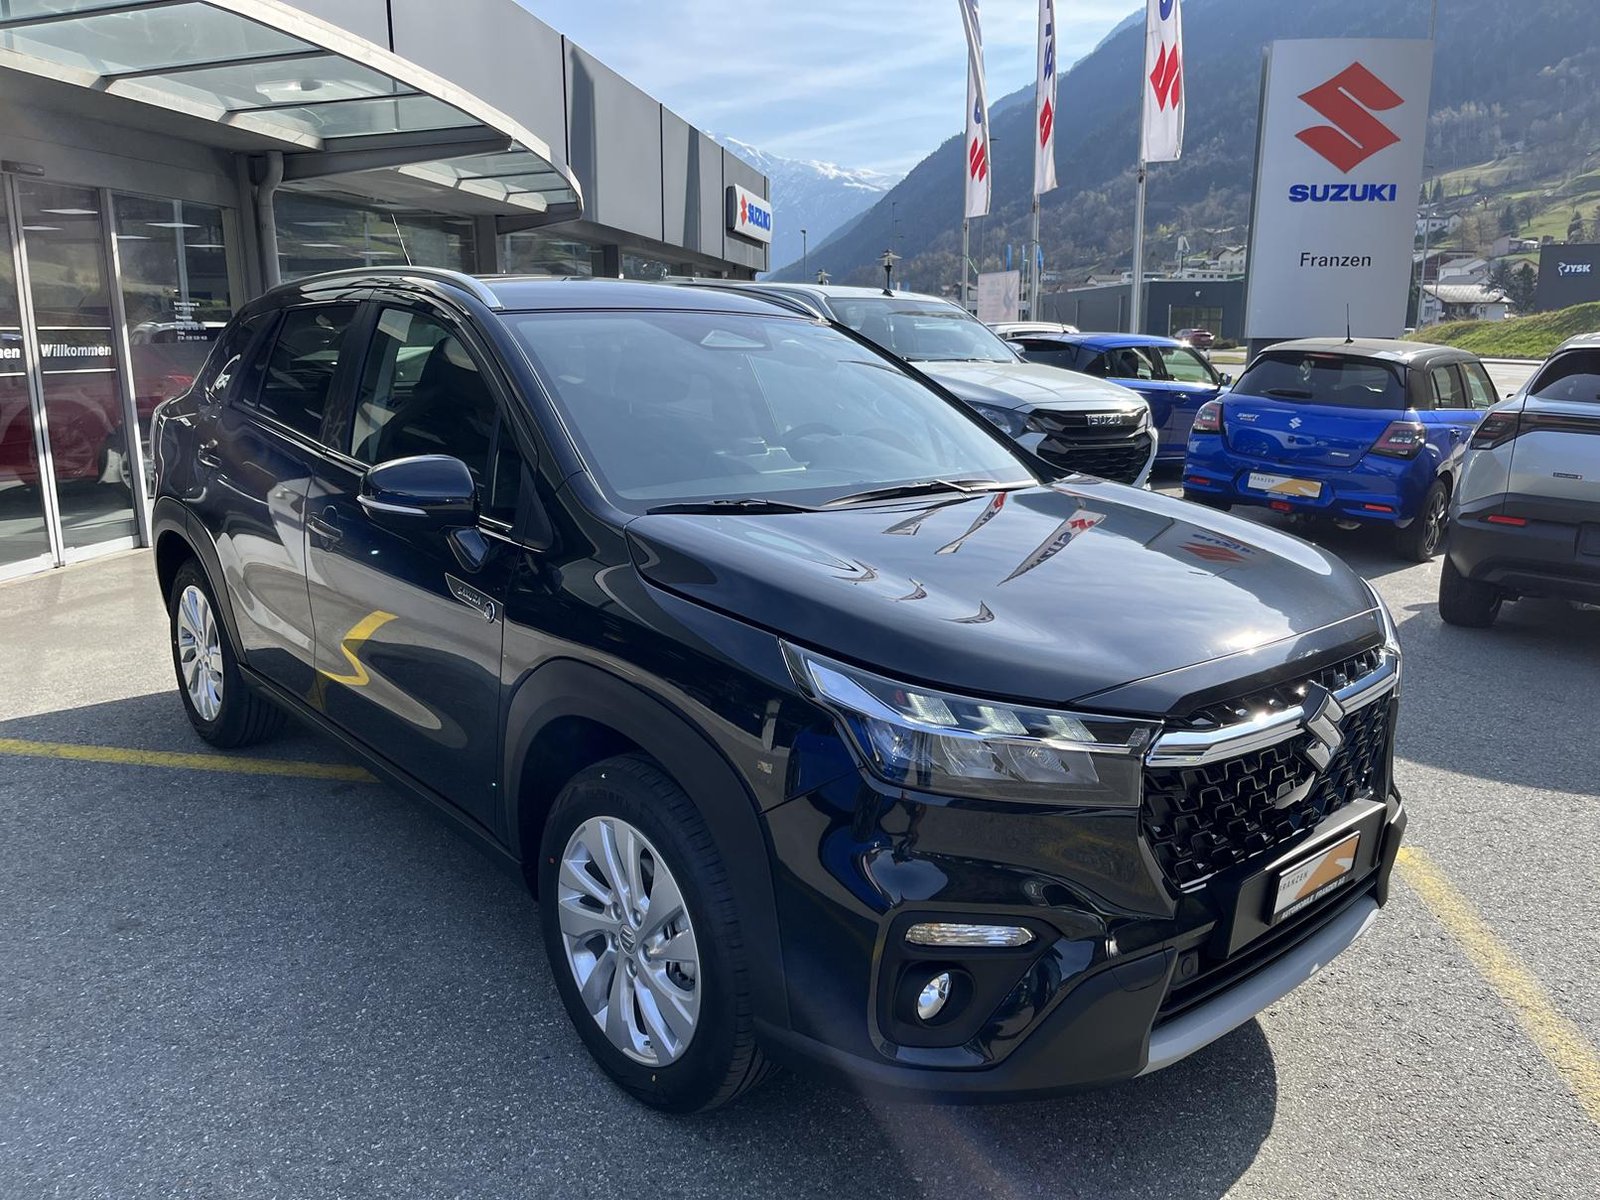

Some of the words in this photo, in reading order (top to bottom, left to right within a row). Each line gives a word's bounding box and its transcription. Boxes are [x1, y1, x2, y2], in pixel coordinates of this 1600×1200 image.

[1288, 183, 1397, 202] SUZUKI
[748, 202, 771, 231] SUZUKI
[1300, 252, 1371, 267] Franzen
[1564, 264, 1591, 273] JYSK
[40, 343, 112, 357] Willkommen
[1085, 413, 1121, 426] ISUZU
